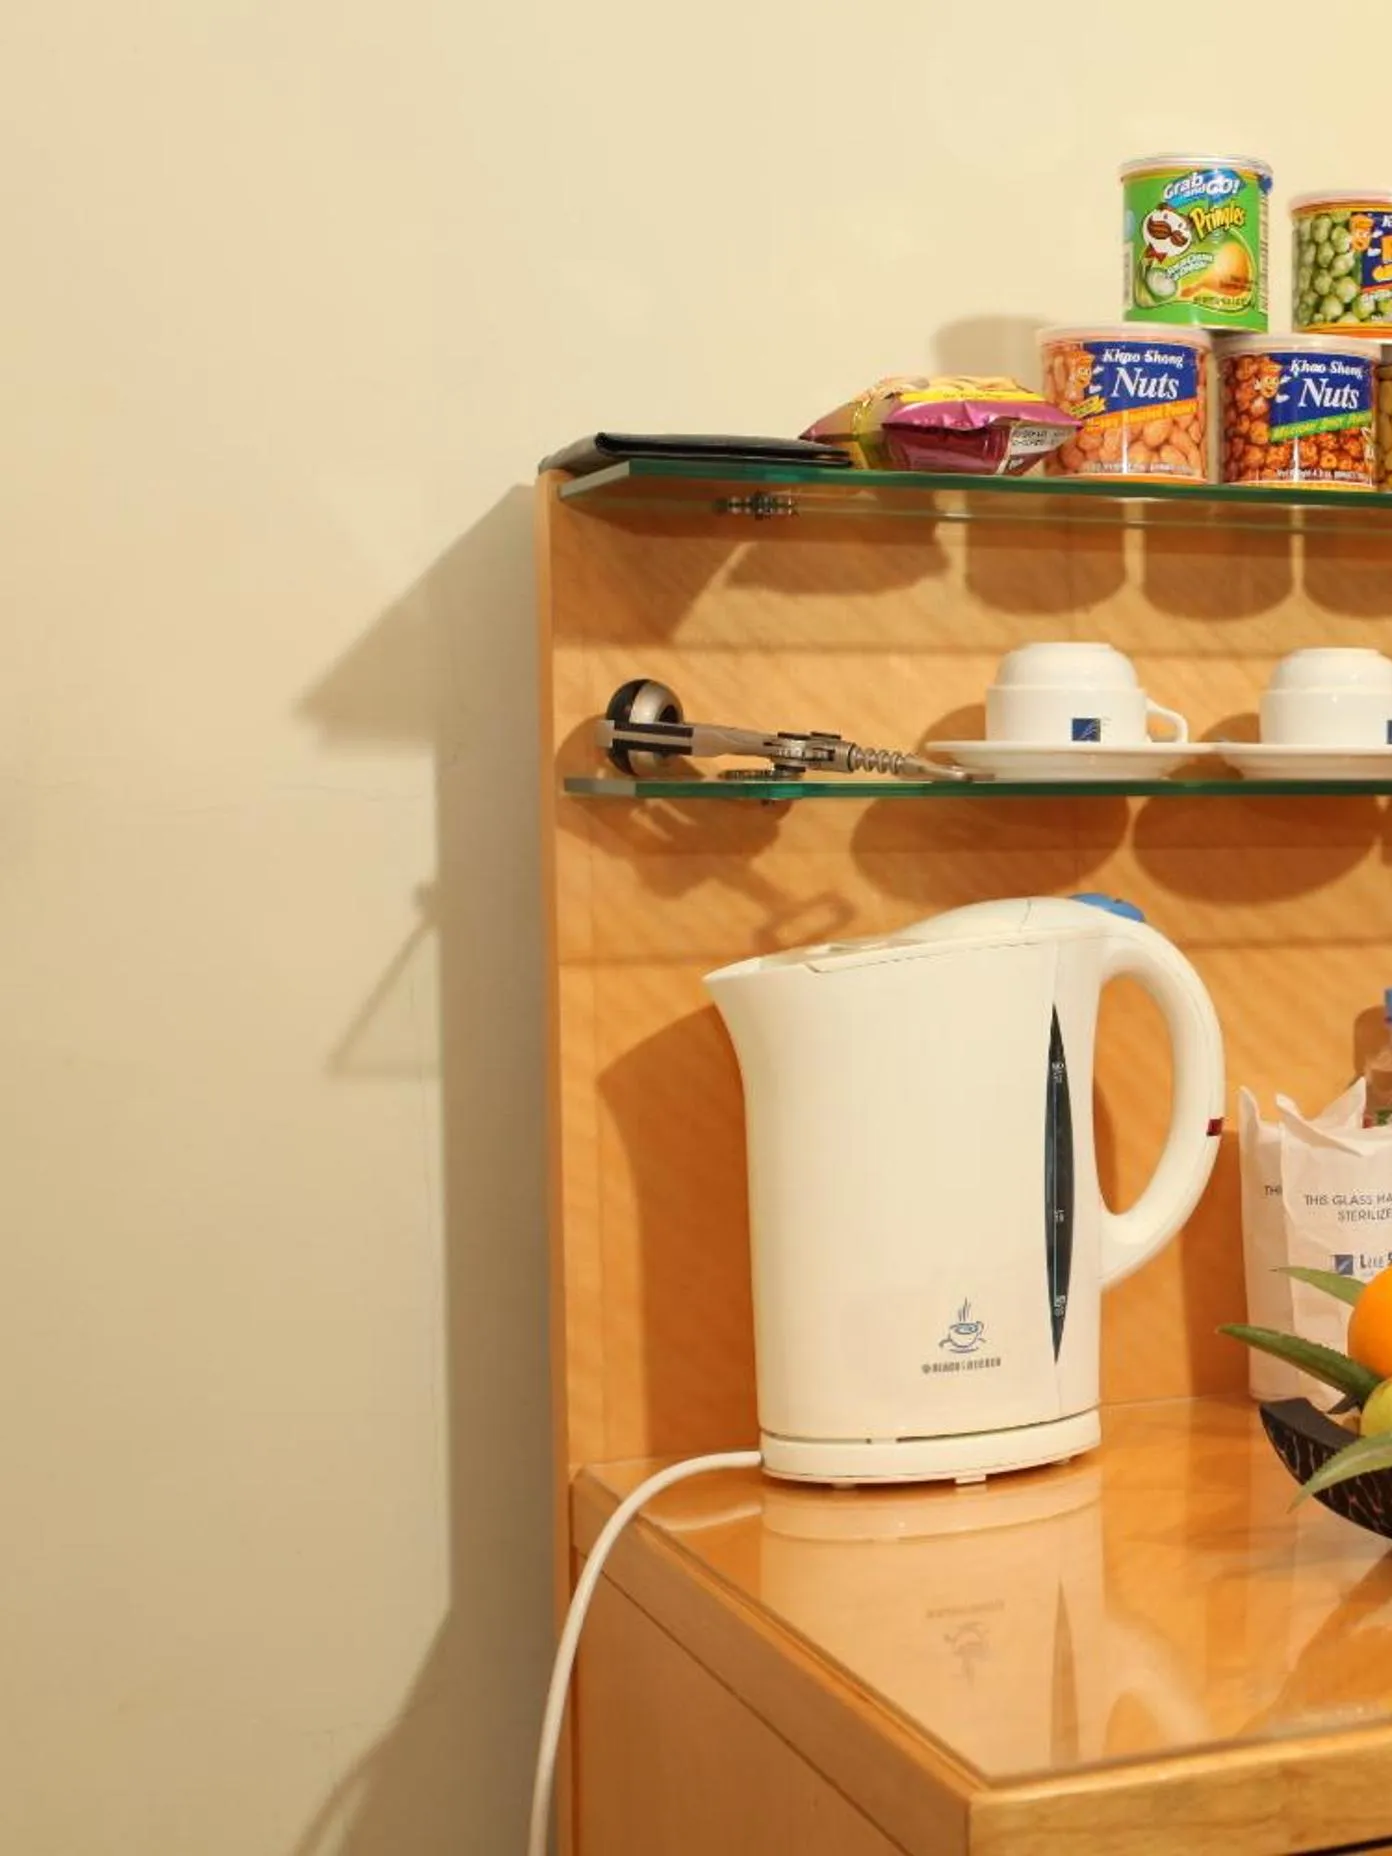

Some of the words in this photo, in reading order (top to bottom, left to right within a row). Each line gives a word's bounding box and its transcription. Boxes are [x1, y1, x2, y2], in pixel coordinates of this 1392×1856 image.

[1144, 350, 1185, 369] Shong
[1290, 359, 1326, 374] Khao
[1330, 360, 1364, 380] Shong
[1110, 366, 1180, 400] Nuts
[1297, 377, 1360, 409] Nuts
[1304, 1193, 1328, 1207] THIS
[1332, 1192, 1373, 1206] GLASS
